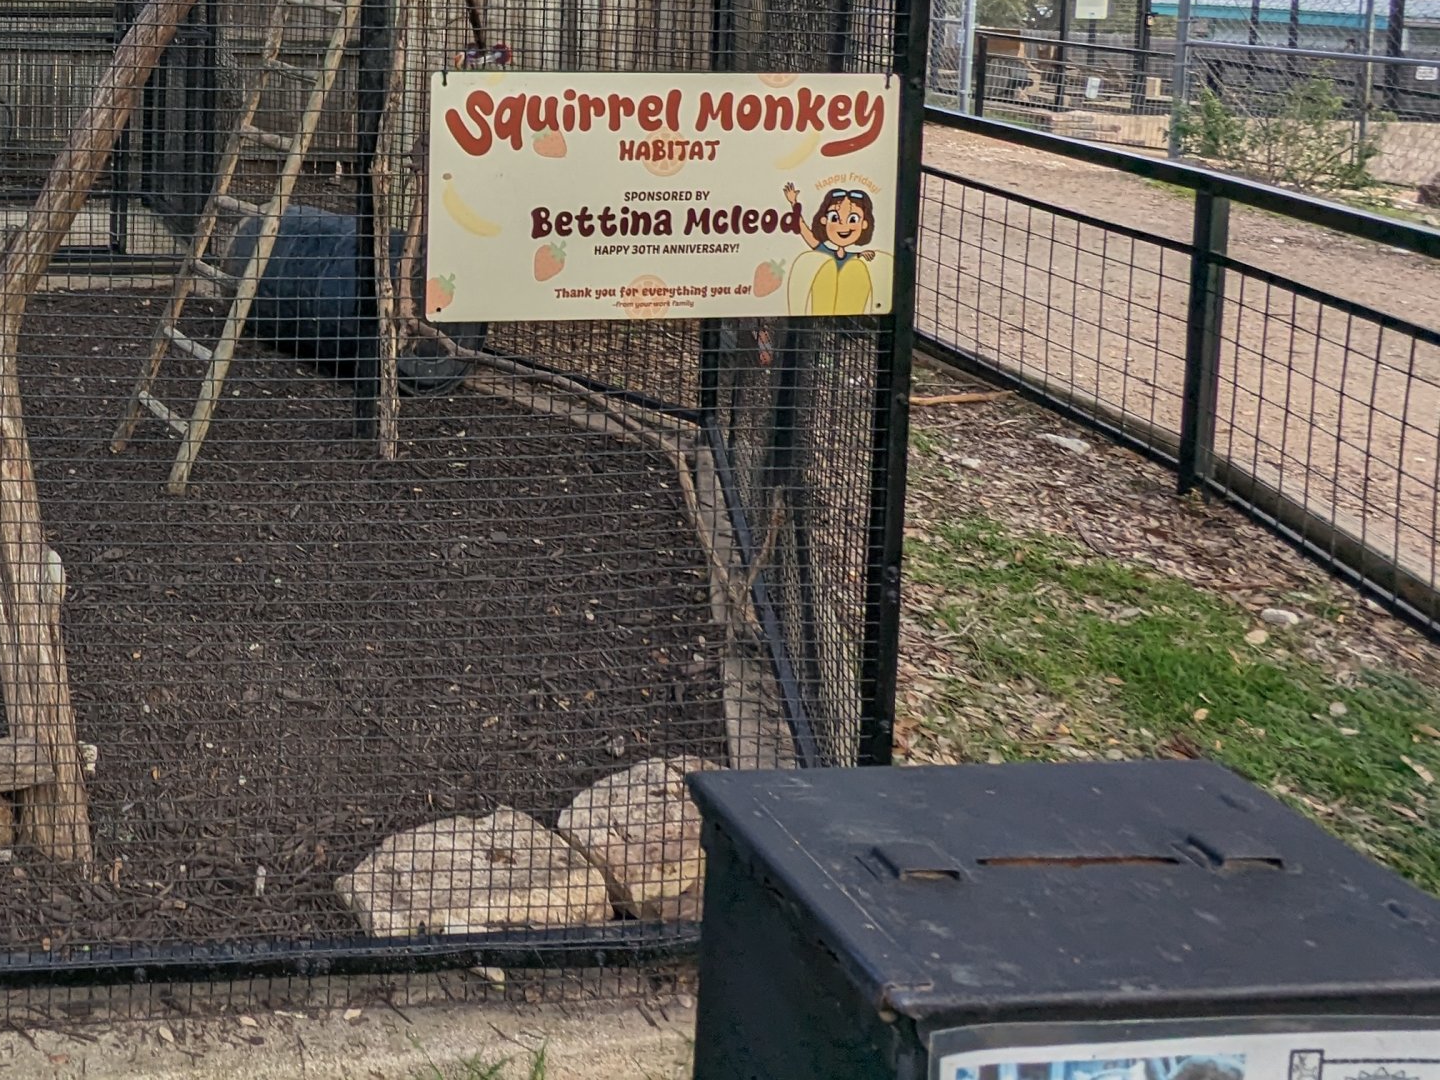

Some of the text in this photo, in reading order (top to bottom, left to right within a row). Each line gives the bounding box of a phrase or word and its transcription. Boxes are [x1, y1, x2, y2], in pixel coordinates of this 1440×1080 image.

[445, 87, 885, 157] Squirrel Monkey
[619, 139, 721, 161] HABITAT
[815, 173, 847, 191] Happy
[624, 190, 710, 202] SPONSORED BY
[530, 206, 673, 239] Bettina
[594, 243, 740, 256] HAPPY 30TH ANNIVERSARY!
[554, 284, 752, 300] Thank you for everything you do!
[672, 299, 695, 308] family
